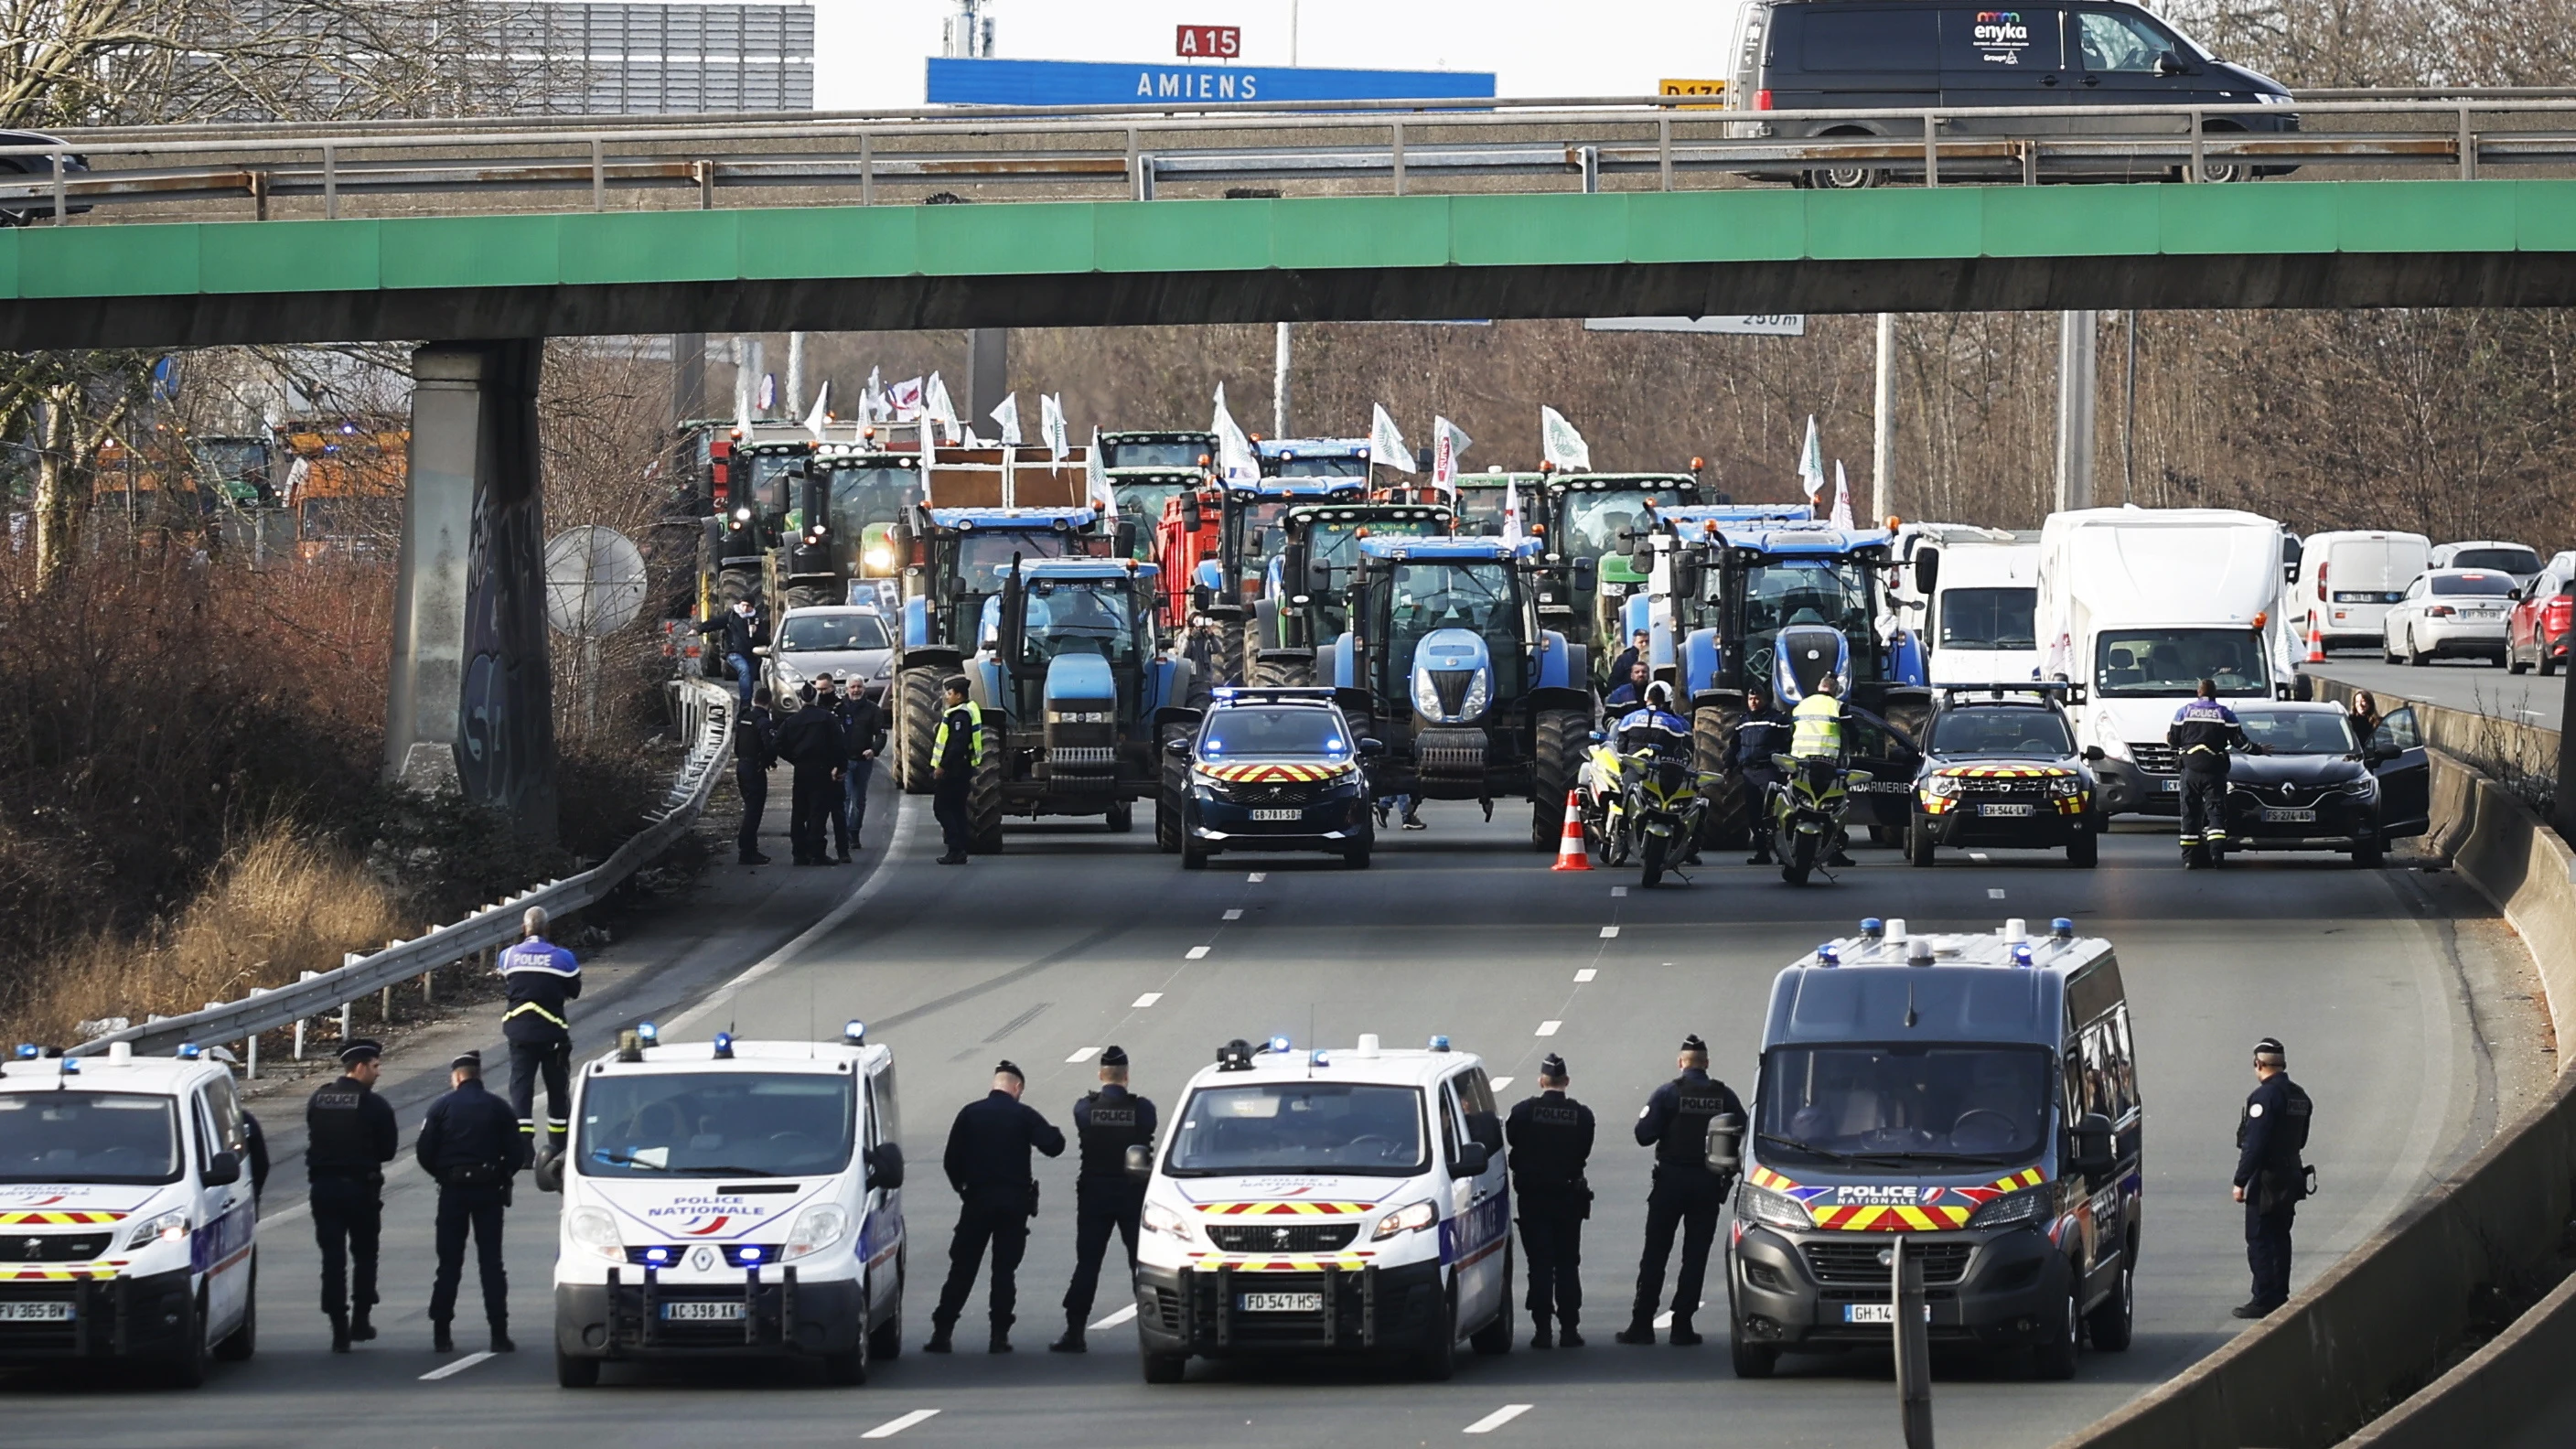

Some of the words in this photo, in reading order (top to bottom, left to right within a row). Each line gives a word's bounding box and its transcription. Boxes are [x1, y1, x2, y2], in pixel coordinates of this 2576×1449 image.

[1974, 22, 2027, 42] enyka
[1182, 29, 1197, 53] A
[1206, 30, 1237, 54] 15
[1137, 72, 1256, 99] AMIENS
[2189, 708, 2217, 718] POLICE
[1849, 781, 1910, 794] NDARMERIE
[513, 953, 552, 966] POLICE
[318, 1094, 358, 1106] POLICE
[1681, 1098, 1722, 1110] POLICE
[1092, 1111, 1133, 1122] POLICE
[1535, 1107, 1575, 1121] POLICE
[1838, 1186, 1917, 1197] POLICE
[674, 1197, 745, 1205] POLICE
[1837, 1197, 1916, 1205] NATIONALE
[649, 1207, 766, 1217] NATIONALE
